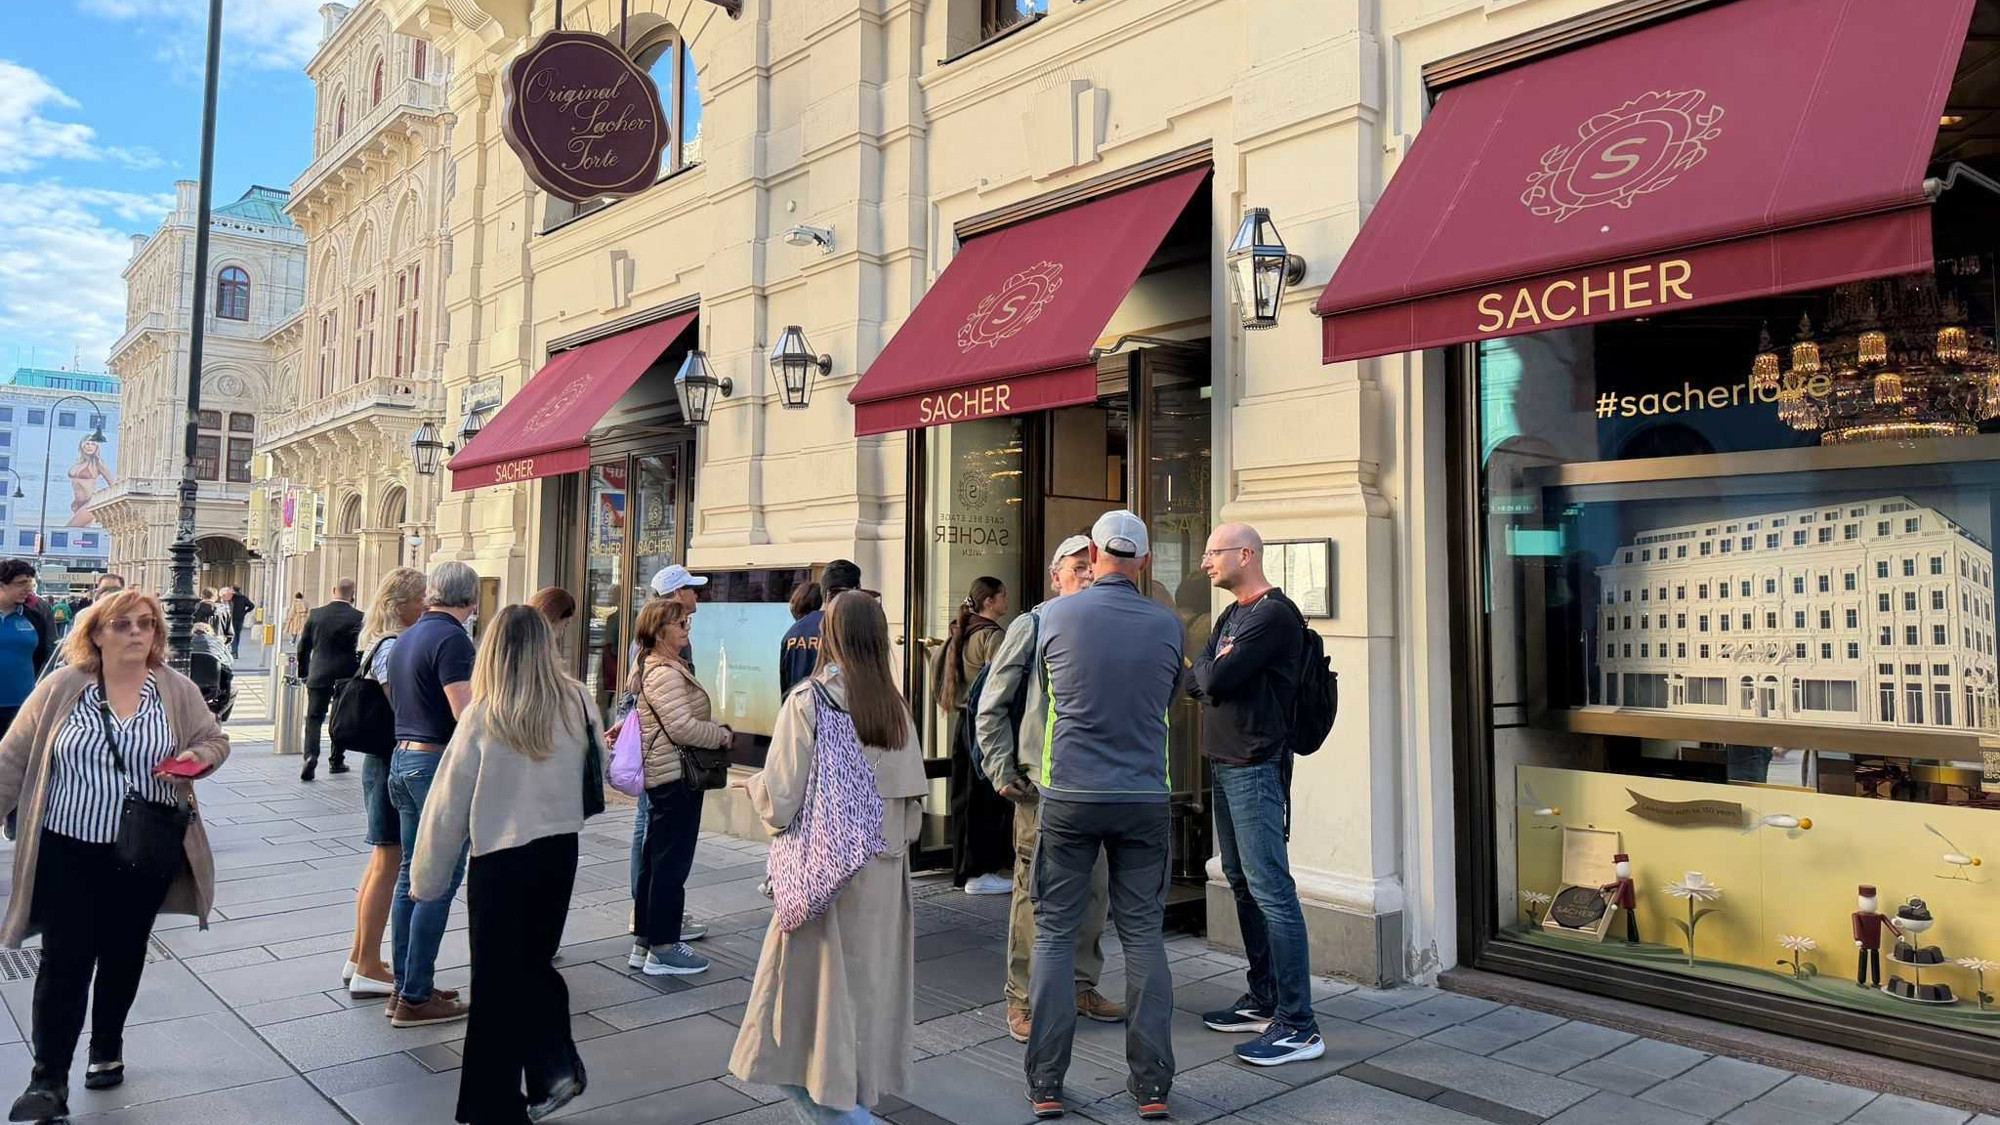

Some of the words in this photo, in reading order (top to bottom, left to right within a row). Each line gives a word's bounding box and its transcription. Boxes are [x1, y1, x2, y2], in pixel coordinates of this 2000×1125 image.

[526, 67, 629, 112] Original
[561, 134, 619, 171] Torte
[1590, 137, 1647, 179] S
[1477, 259, 1693, 333] SACHER
[920, 384, 1011, 424] SACHER
[1595, 373, 1833, 419] #sacherlove
[495, 459, 534, 482] SACHER
[787, 636, 821, 651] PAR
